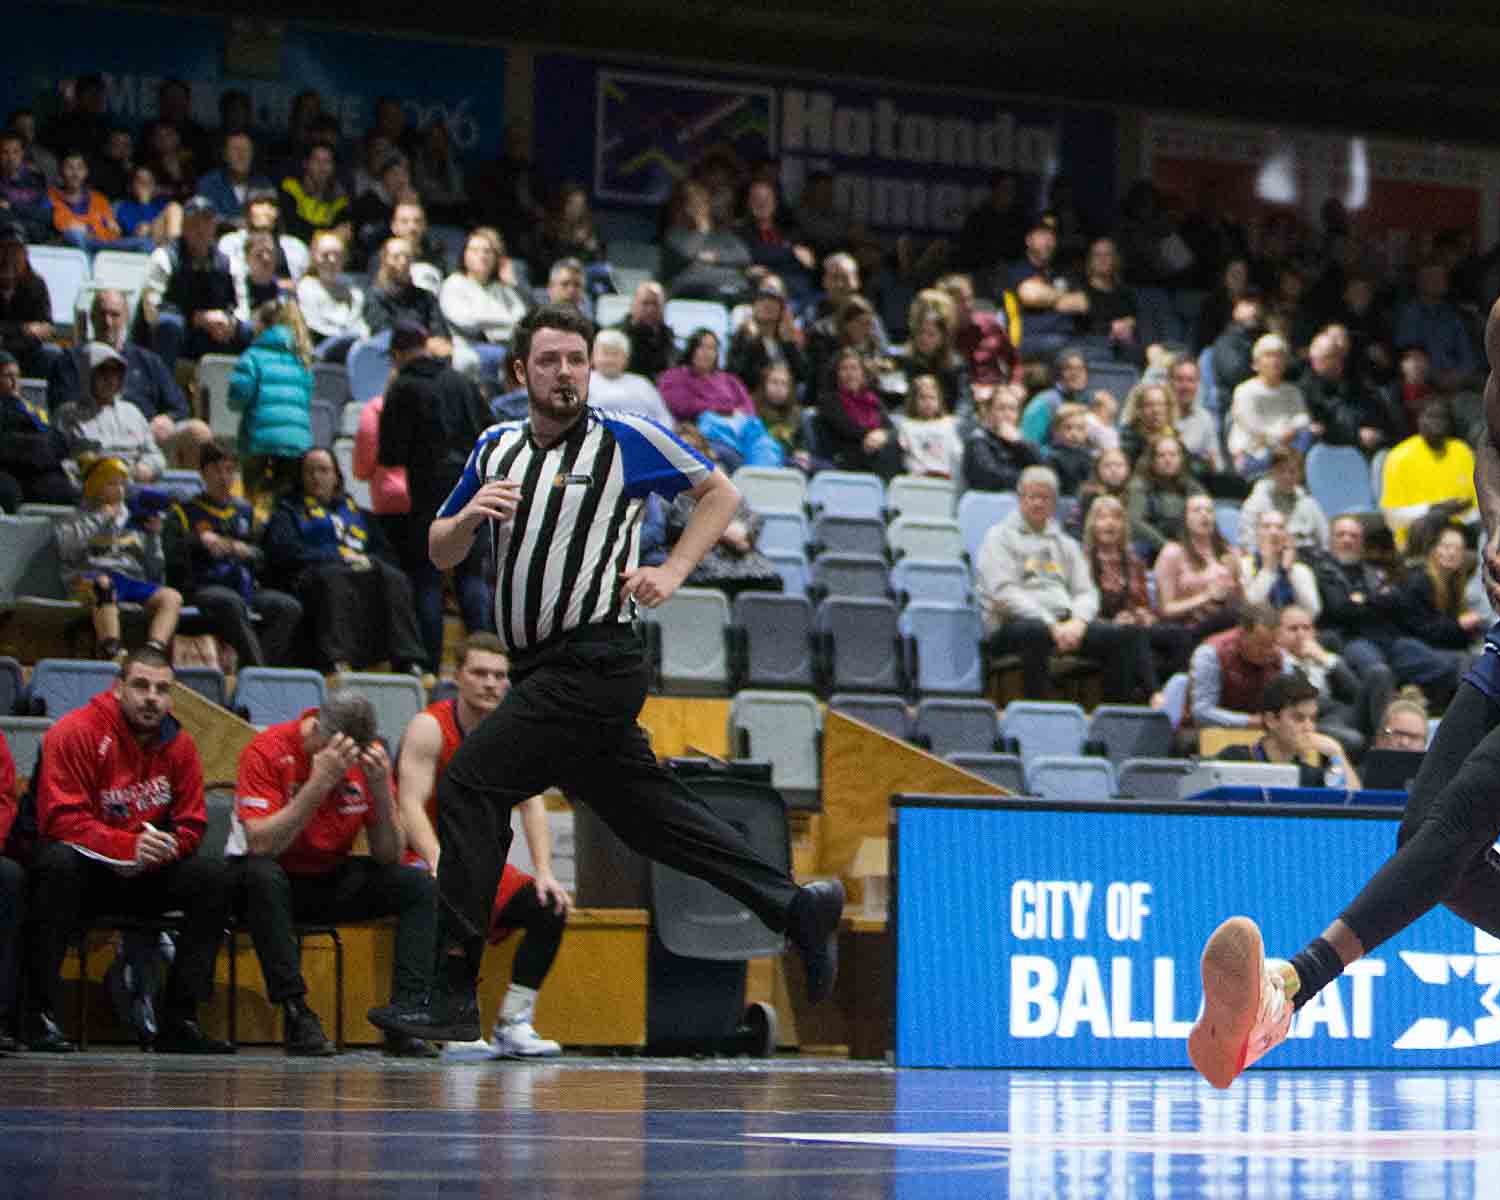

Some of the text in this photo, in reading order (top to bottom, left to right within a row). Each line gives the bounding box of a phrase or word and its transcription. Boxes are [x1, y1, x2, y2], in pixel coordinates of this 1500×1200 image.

[781, 89, 1058, 173] Hotondo
[1010, 880, 1152, 941] CITY OF
[1009, 955, 1386, 1039] BALLAT
